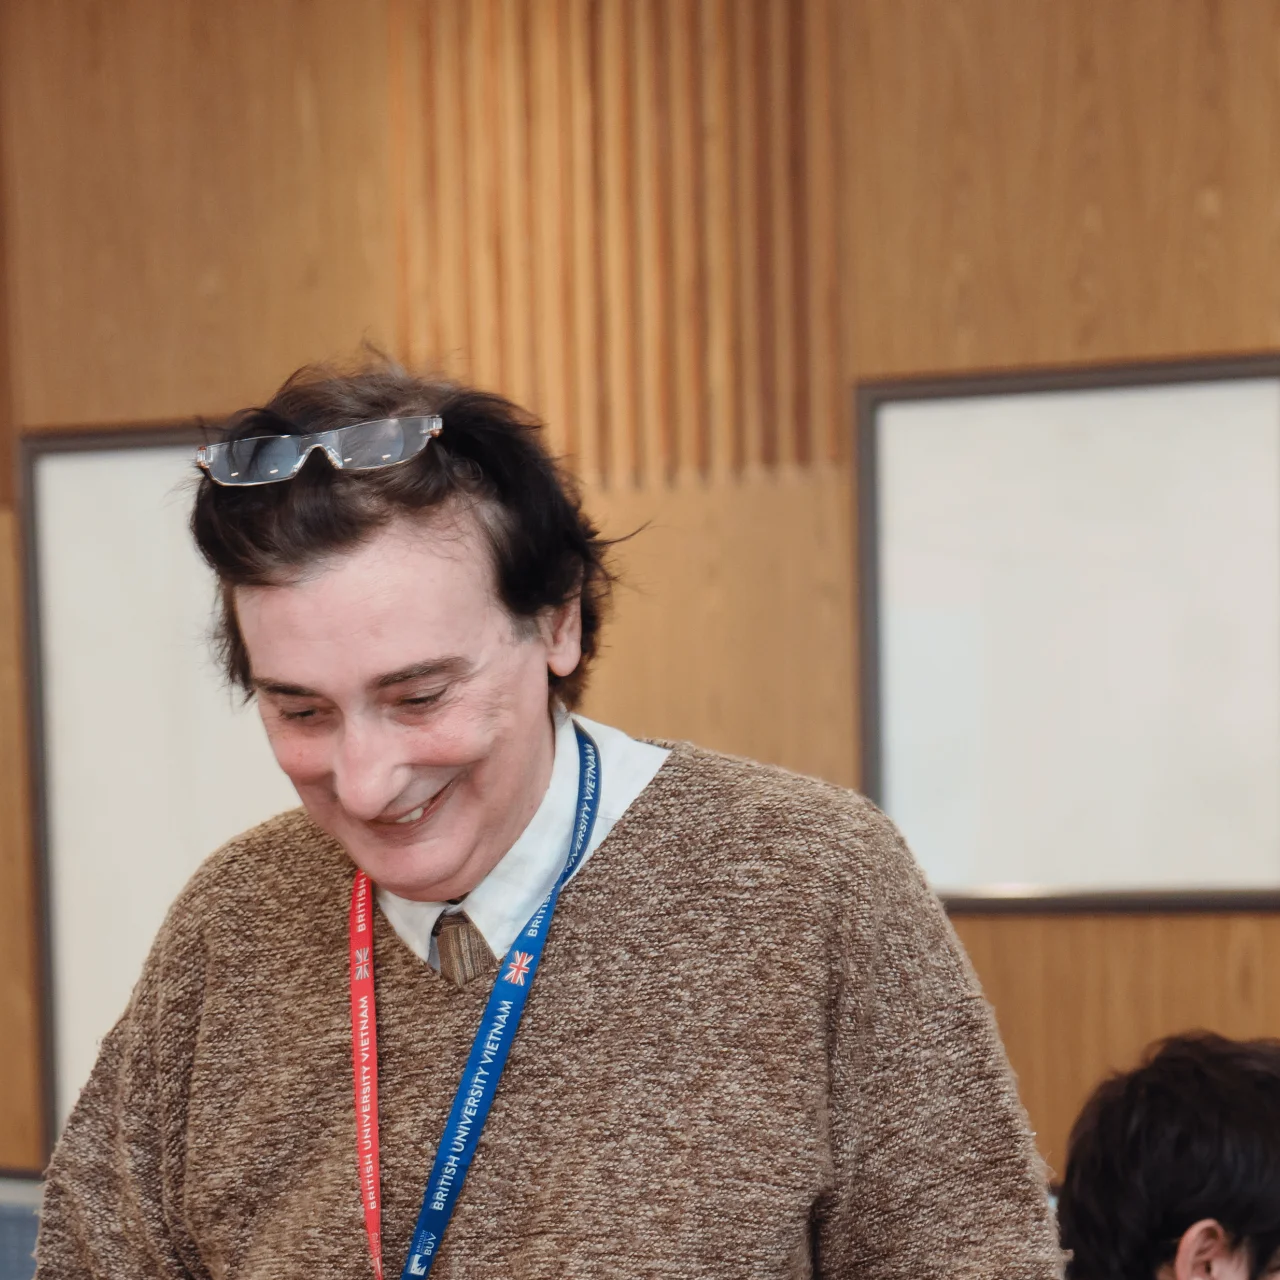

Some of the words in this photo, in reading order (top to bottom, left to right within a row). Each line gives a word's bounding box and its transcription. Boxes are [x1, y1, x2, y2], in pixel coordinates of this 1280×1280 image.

[565, 801, 591, 873] NIVERSITY
[583, 743, 597, 801] VIETNAM
[357, 995, 370, 1063] VIETNAM
[358, 1065, 372, 1150] UNIVERSITY
[431, 1155, 460, 1211] BRITISH
[453, 1066, 490, 1153] UNIVERSITY
[482, 1000, 513, 1066] VIETNAM
[364, 1153, 377, 1210] BRITISH
[424, 1232, 436, 1256] BUV
